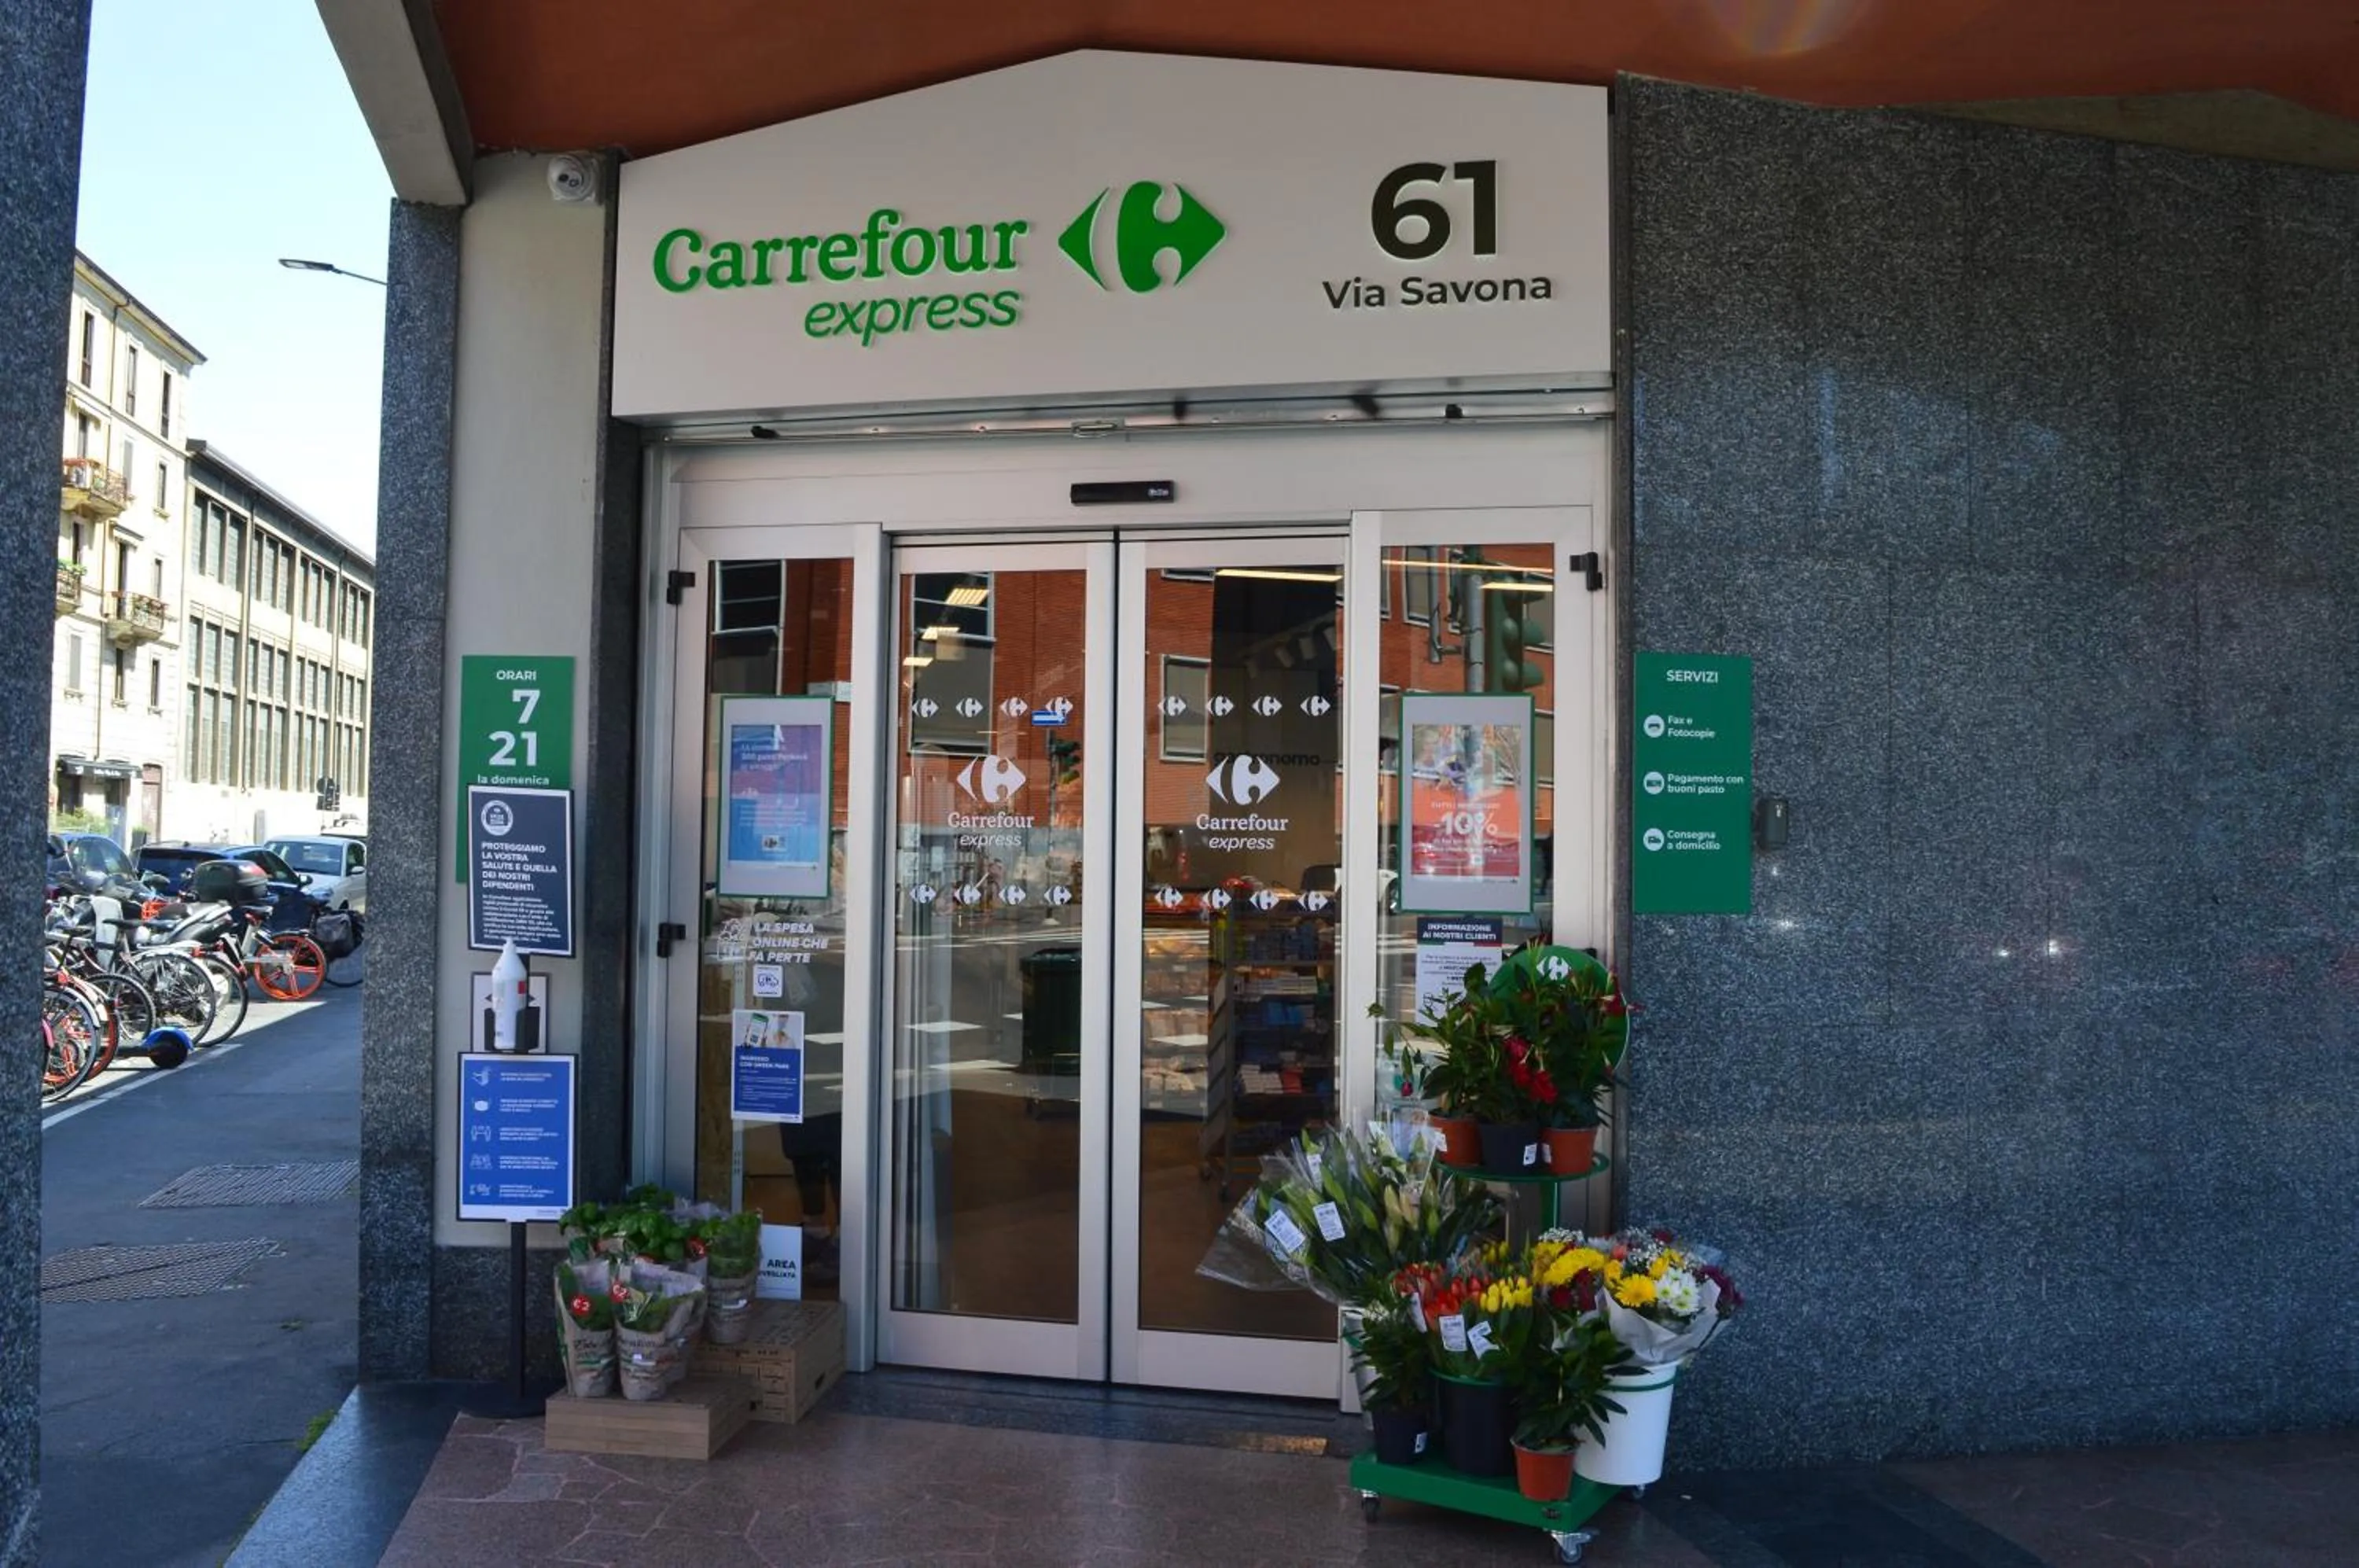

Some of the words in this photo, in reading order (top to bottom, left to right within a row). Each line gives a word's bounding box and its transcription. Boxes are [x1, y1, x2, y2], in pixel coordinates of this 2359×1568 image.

[1371, 160, 1496, 259] 61
[653, 208, 1028, 293] Carrefour
[1322, 277, 1386, 308] Via
[1400, 276, 1552, 305] Savona
[804, 290, 1021, 346] express
[496, 670, 537, 680] ORARI
[1666, 669, 1718, 683] SERVIZI
[512, 689, 540, 724] 7
[1668, 715, 1684, 724] Fax
[1668, 727, 1716, 740] Fotocopie
[488, 731, 537, 767] 21
[477, 774, 488, 784] la
[491, 775, 550, 786] domenica
[1668, 773, 1724, 784] Pagamento
[1668, 785, 1696, 793] buoni
[1698, 786, 1725, 795] pasto
[948, 812, 1035, 828] Carrefour
[1196, 813, 1289, 830] Carrefour
[959, 834, 1021, 848] express
[1667, 830, 1717, 841] Consegna
[1209, 837, 1275, 852] express
[1676, 841, 1720, 850] domicilio
[755, 922, 771, 933] LA
[775, 922, 815, 934] SPESA
[753, 937, 800, 948] ONLINE
[802, 937, 830, 950] CHE
[767, 1259, 797, 1270] AREA
